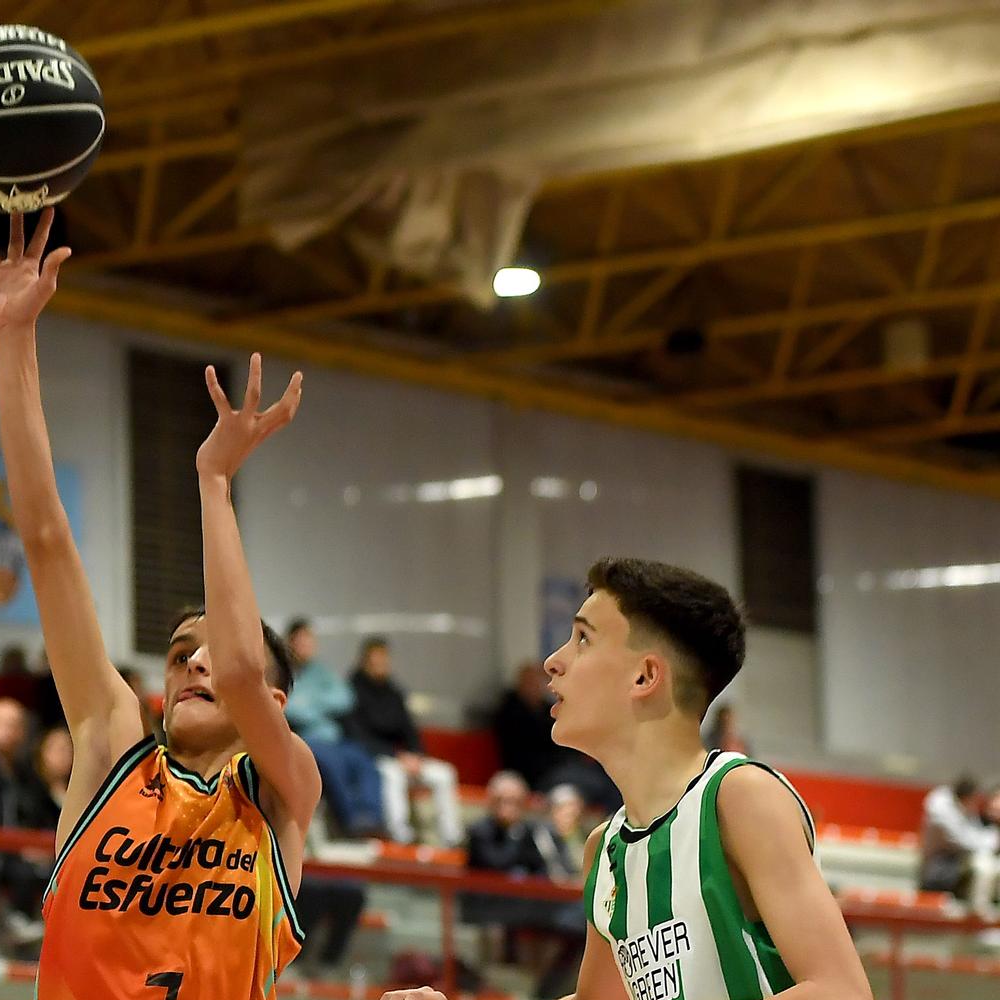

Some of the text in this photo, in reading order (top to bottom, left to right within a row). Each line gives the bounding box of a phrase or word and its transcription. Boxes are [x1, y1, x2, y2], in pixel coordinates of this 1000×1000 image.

[95, 826, 258, 874] Cultura del
[79, 866, 256, 920] Esfuerzo
